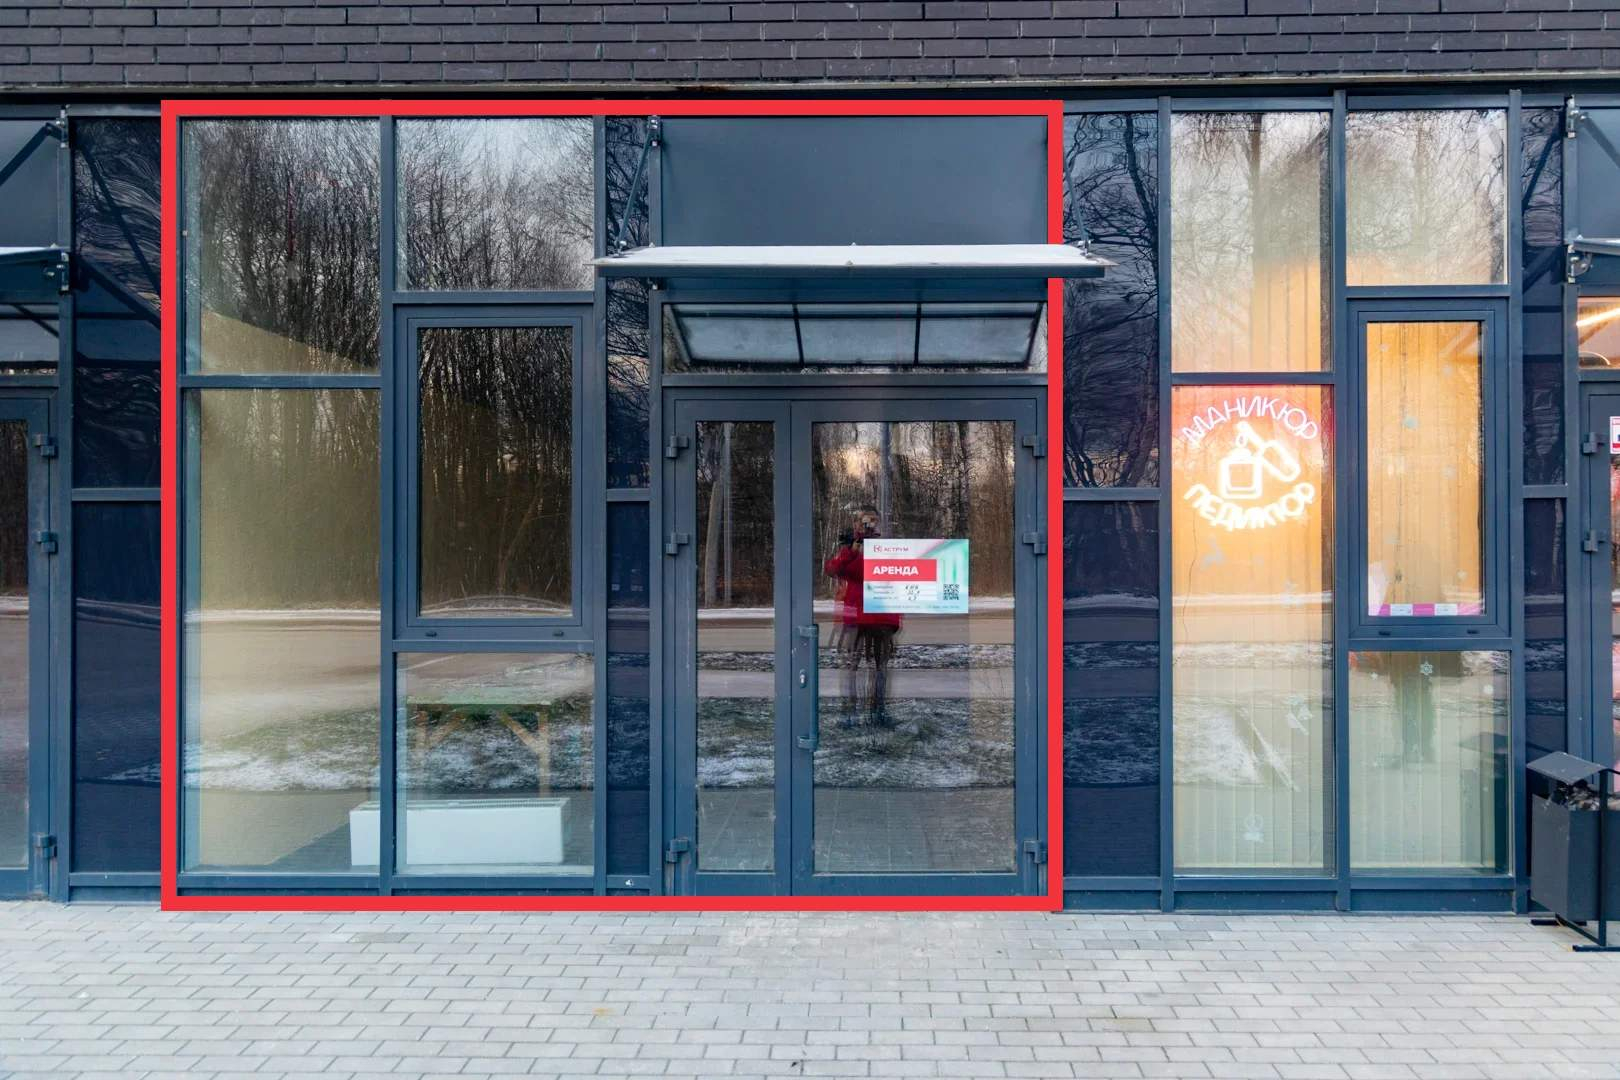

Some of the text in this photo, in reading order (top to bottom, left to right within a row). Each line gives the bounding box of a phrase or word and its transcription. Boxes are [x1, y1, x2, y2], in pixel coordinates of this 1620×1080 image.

[1181, 395, 1319, 443] МАНИКЮР
[1183, 482, 1316, 532] ПЕДИКЮР
[872, 566, 919, 576] АРЕНДА
